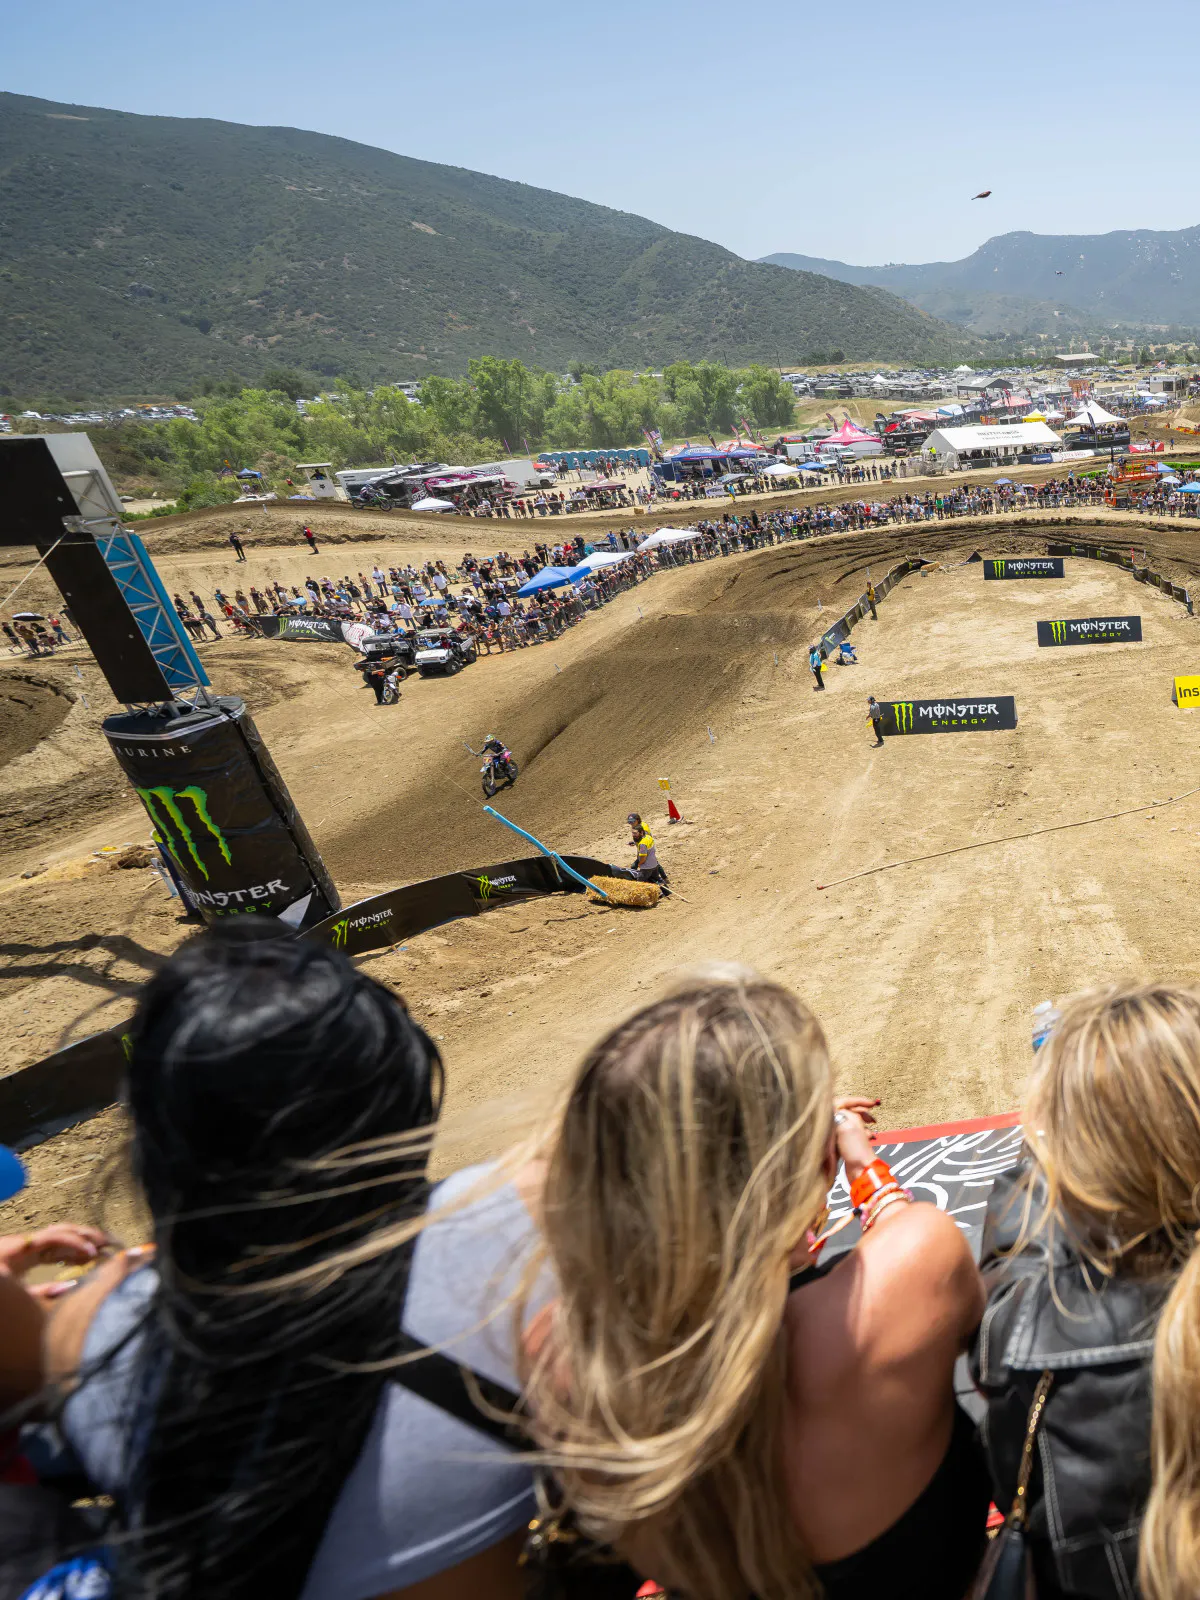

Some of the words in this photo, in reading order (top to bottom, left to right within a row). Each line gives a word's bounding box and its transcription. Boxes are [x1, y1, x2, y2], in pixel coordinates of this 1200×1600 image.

[1008, 560, 1055, 570] MONSTER
[288, 619, 331, 631] MONSTER
[1070, 620, 1131, 634] MONSTER
[919, 703, 1000, 719] MONSTER
[931, 718, 987, 726] ENERGY
[350, 908, 394, 928] MONSTER
